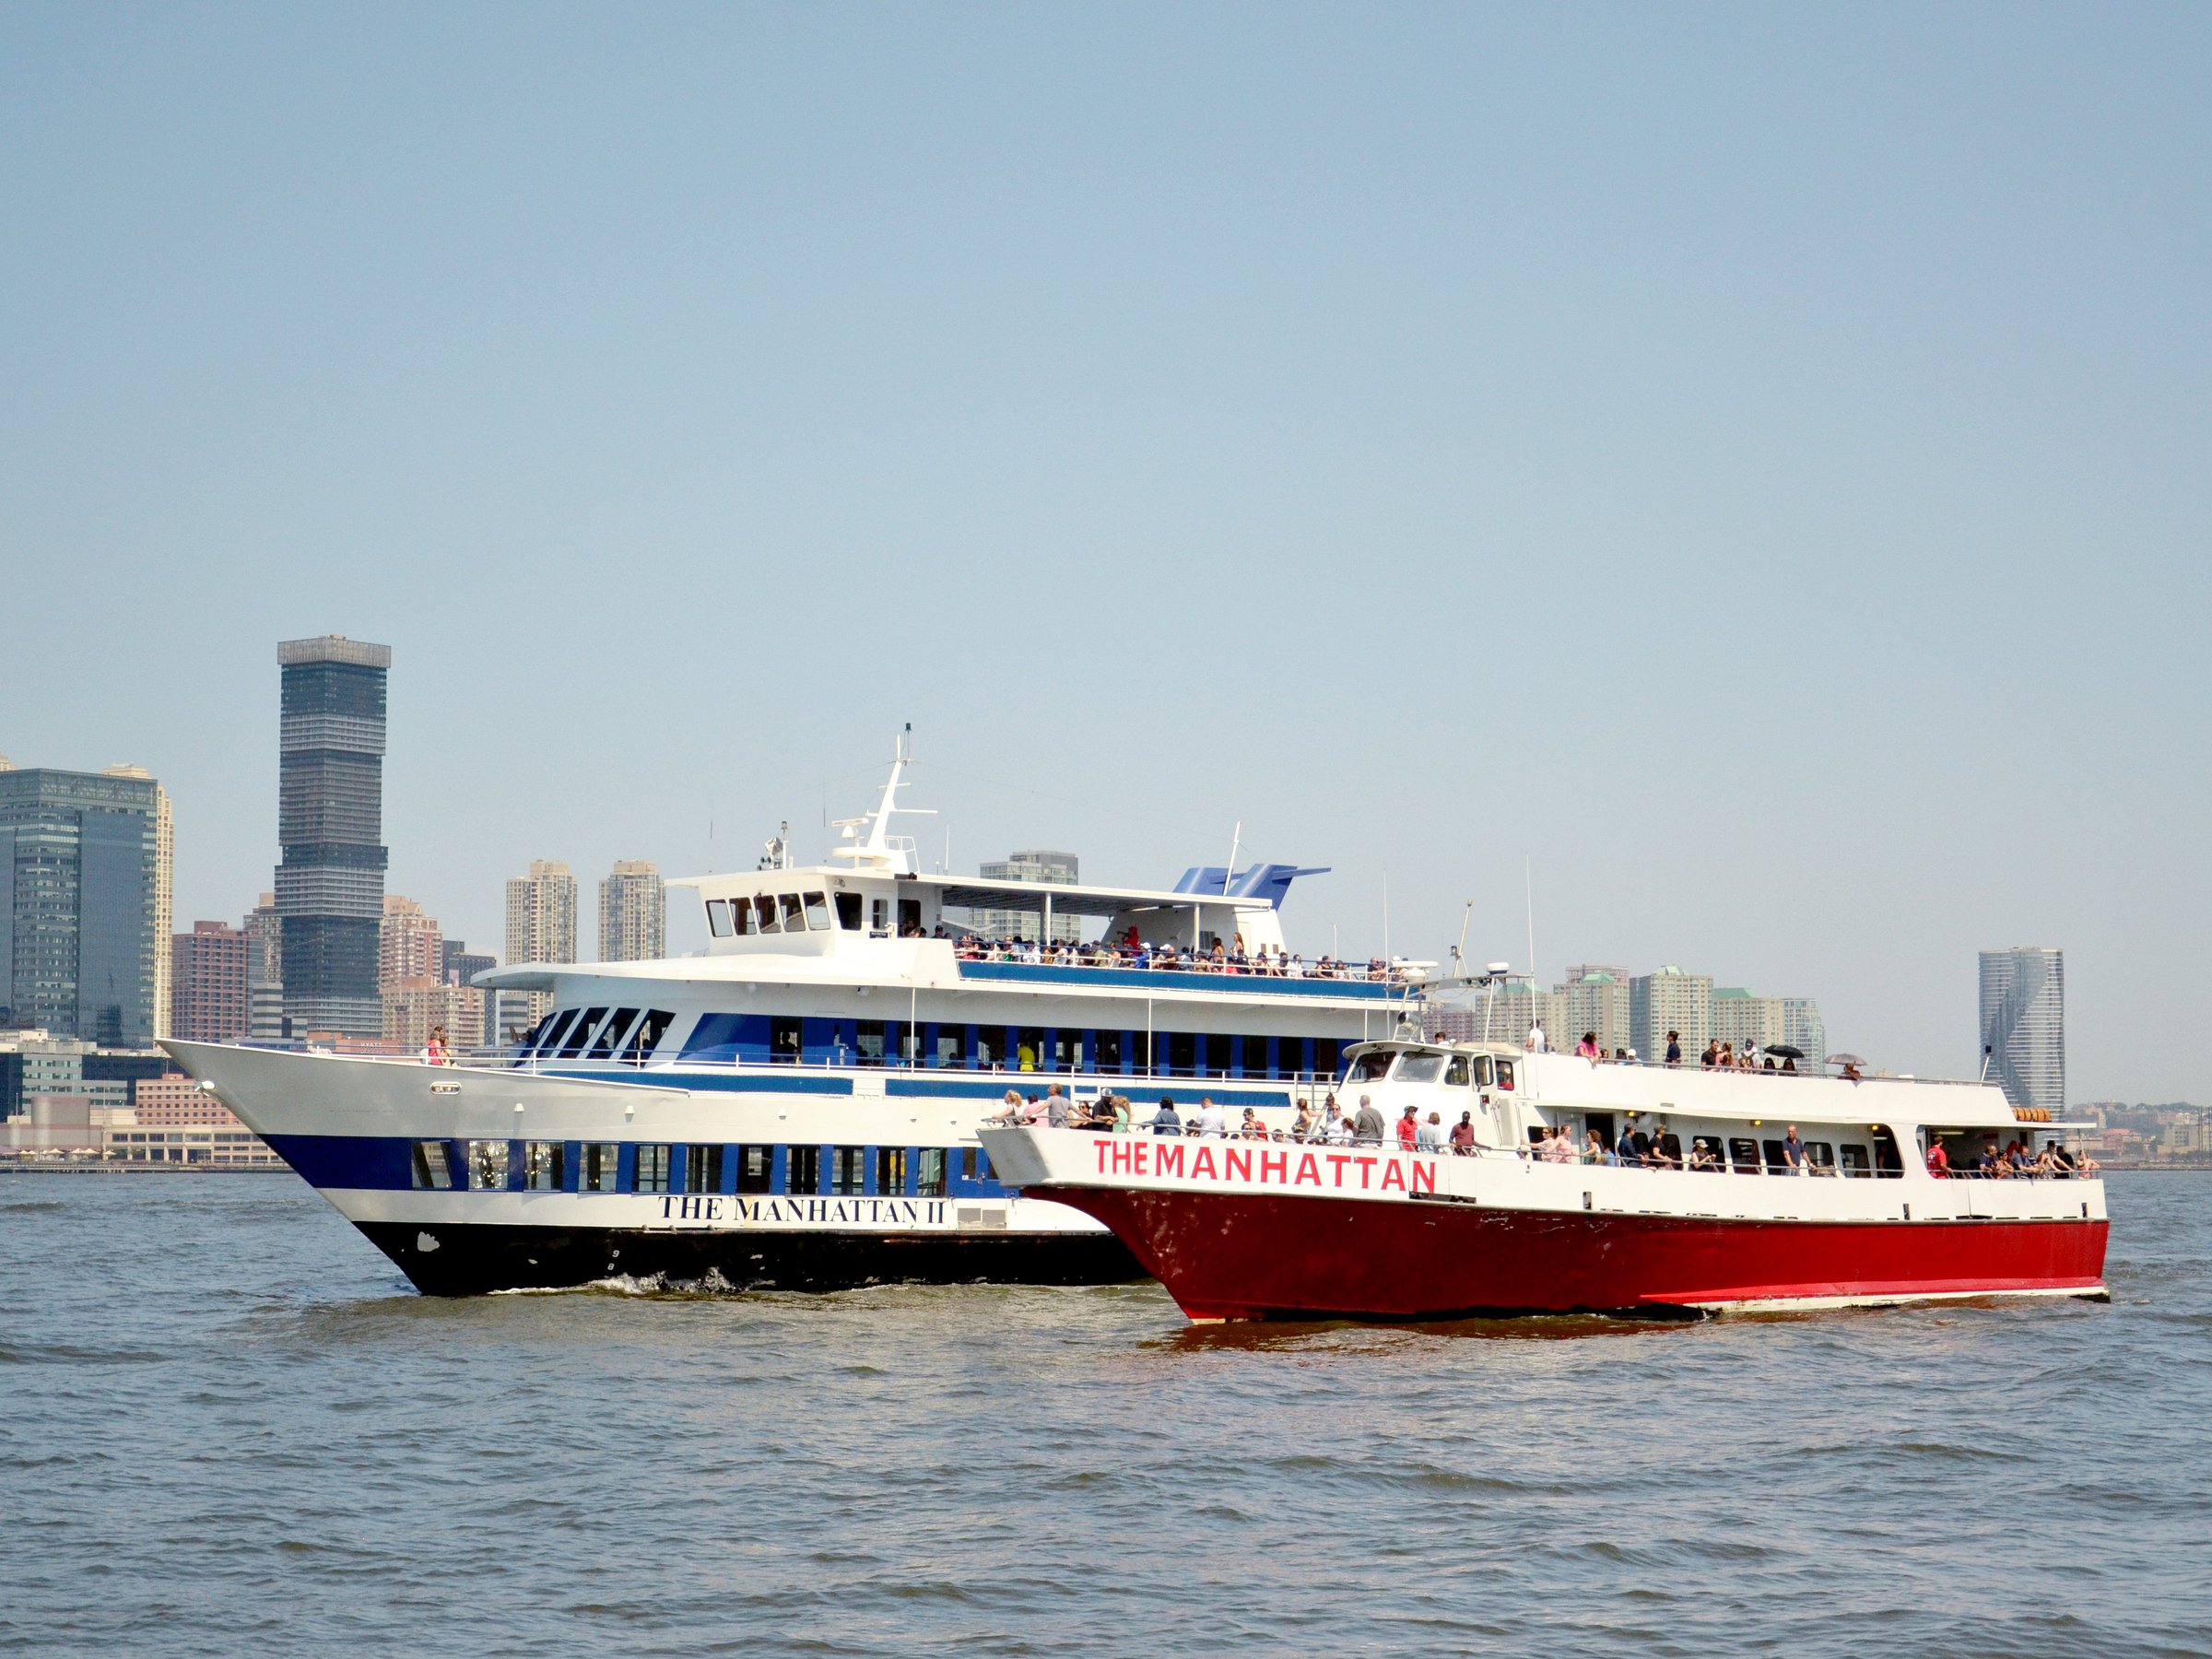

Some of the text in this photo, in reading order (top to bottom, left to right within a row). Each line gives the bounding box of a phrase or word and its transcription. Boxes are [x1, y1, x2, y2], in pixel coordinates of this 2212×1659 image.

[1093, 1139, 1436, 1194] THE MANHATTAN
[658, 1195, 946, 1224] THE MANHATTAN II
[612, 1249, 620, 1258] 9
[606, 1263, 615, 1271] 8
